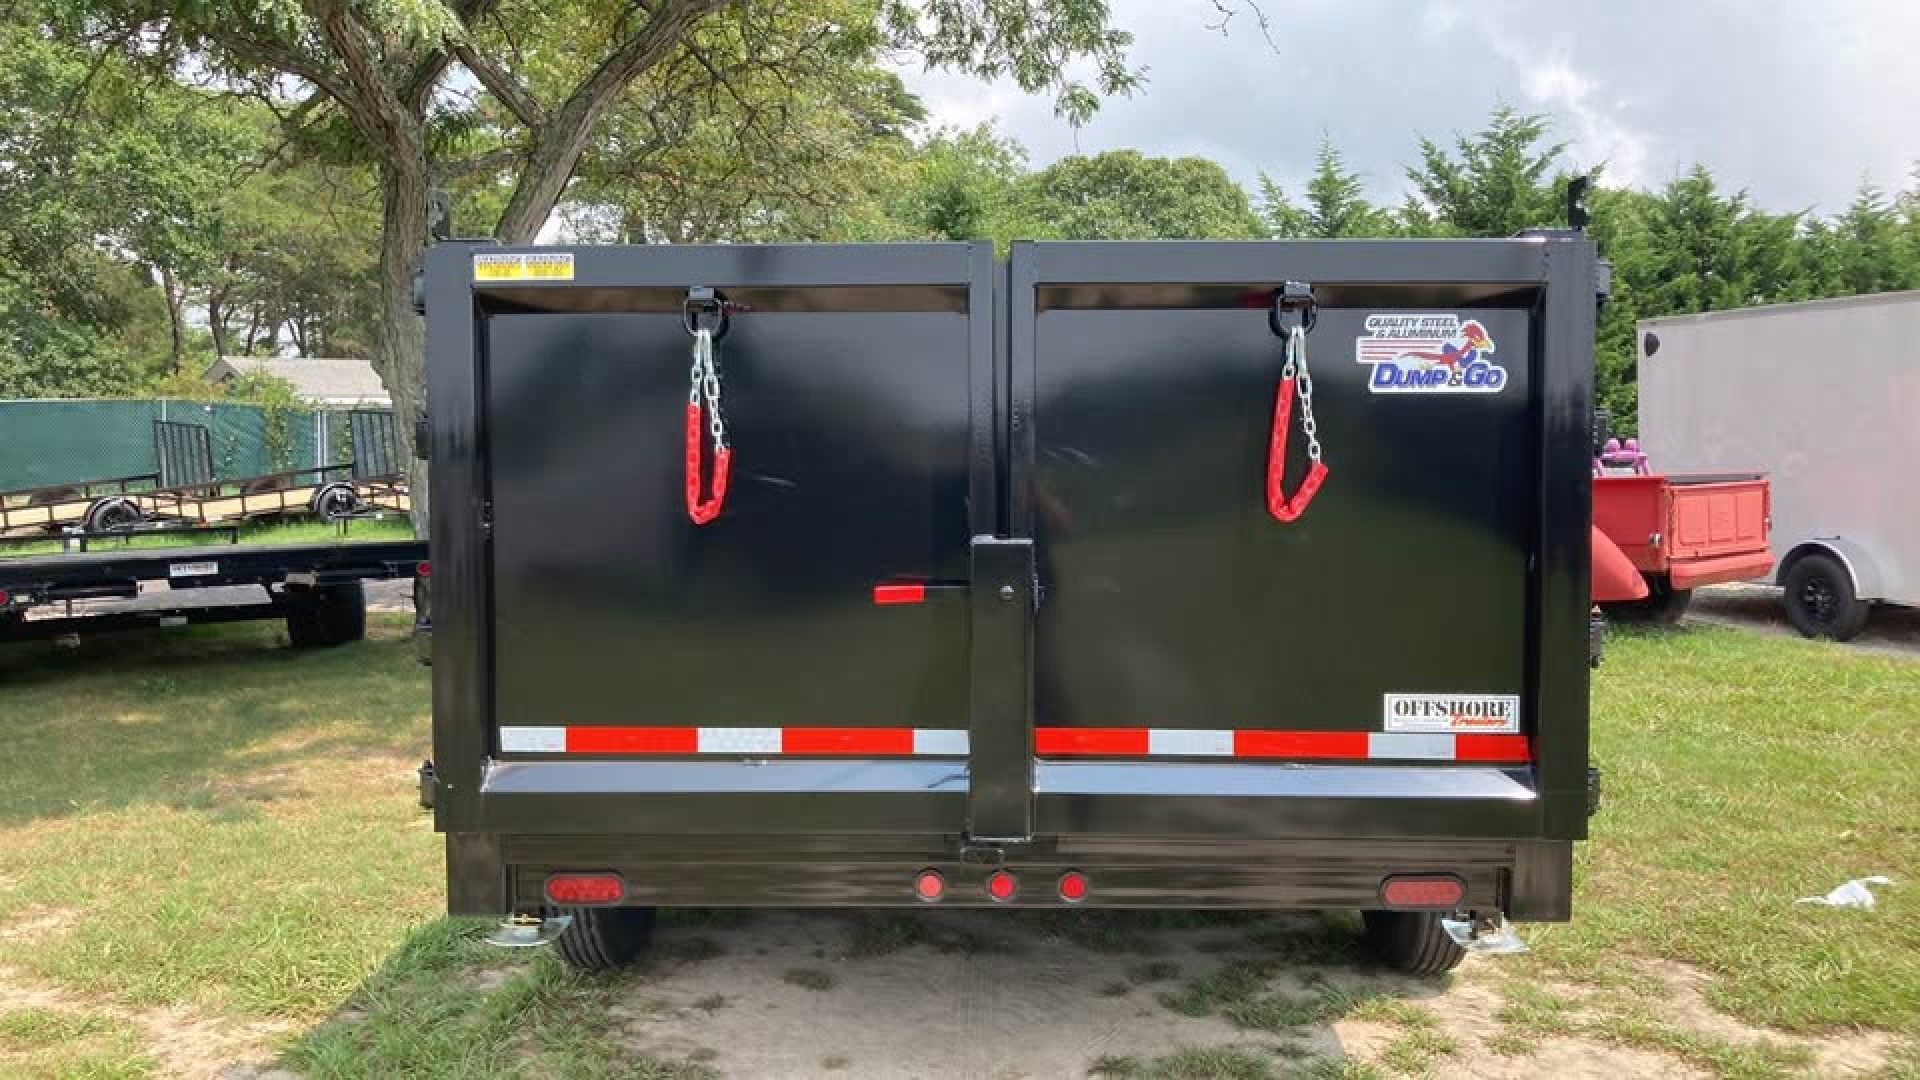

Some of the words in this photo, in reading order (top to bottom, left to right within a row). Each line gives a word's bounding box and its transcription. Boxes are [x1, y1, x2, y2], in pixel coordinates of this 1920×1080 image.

[1368, 317, 1418, 327] QUALITY
[1420, 317, 1458, 327] STEEL
[1385, 329, 1457, 338] ALUMINUM
[1394, 700, 1510, 716] OFFSHORE
